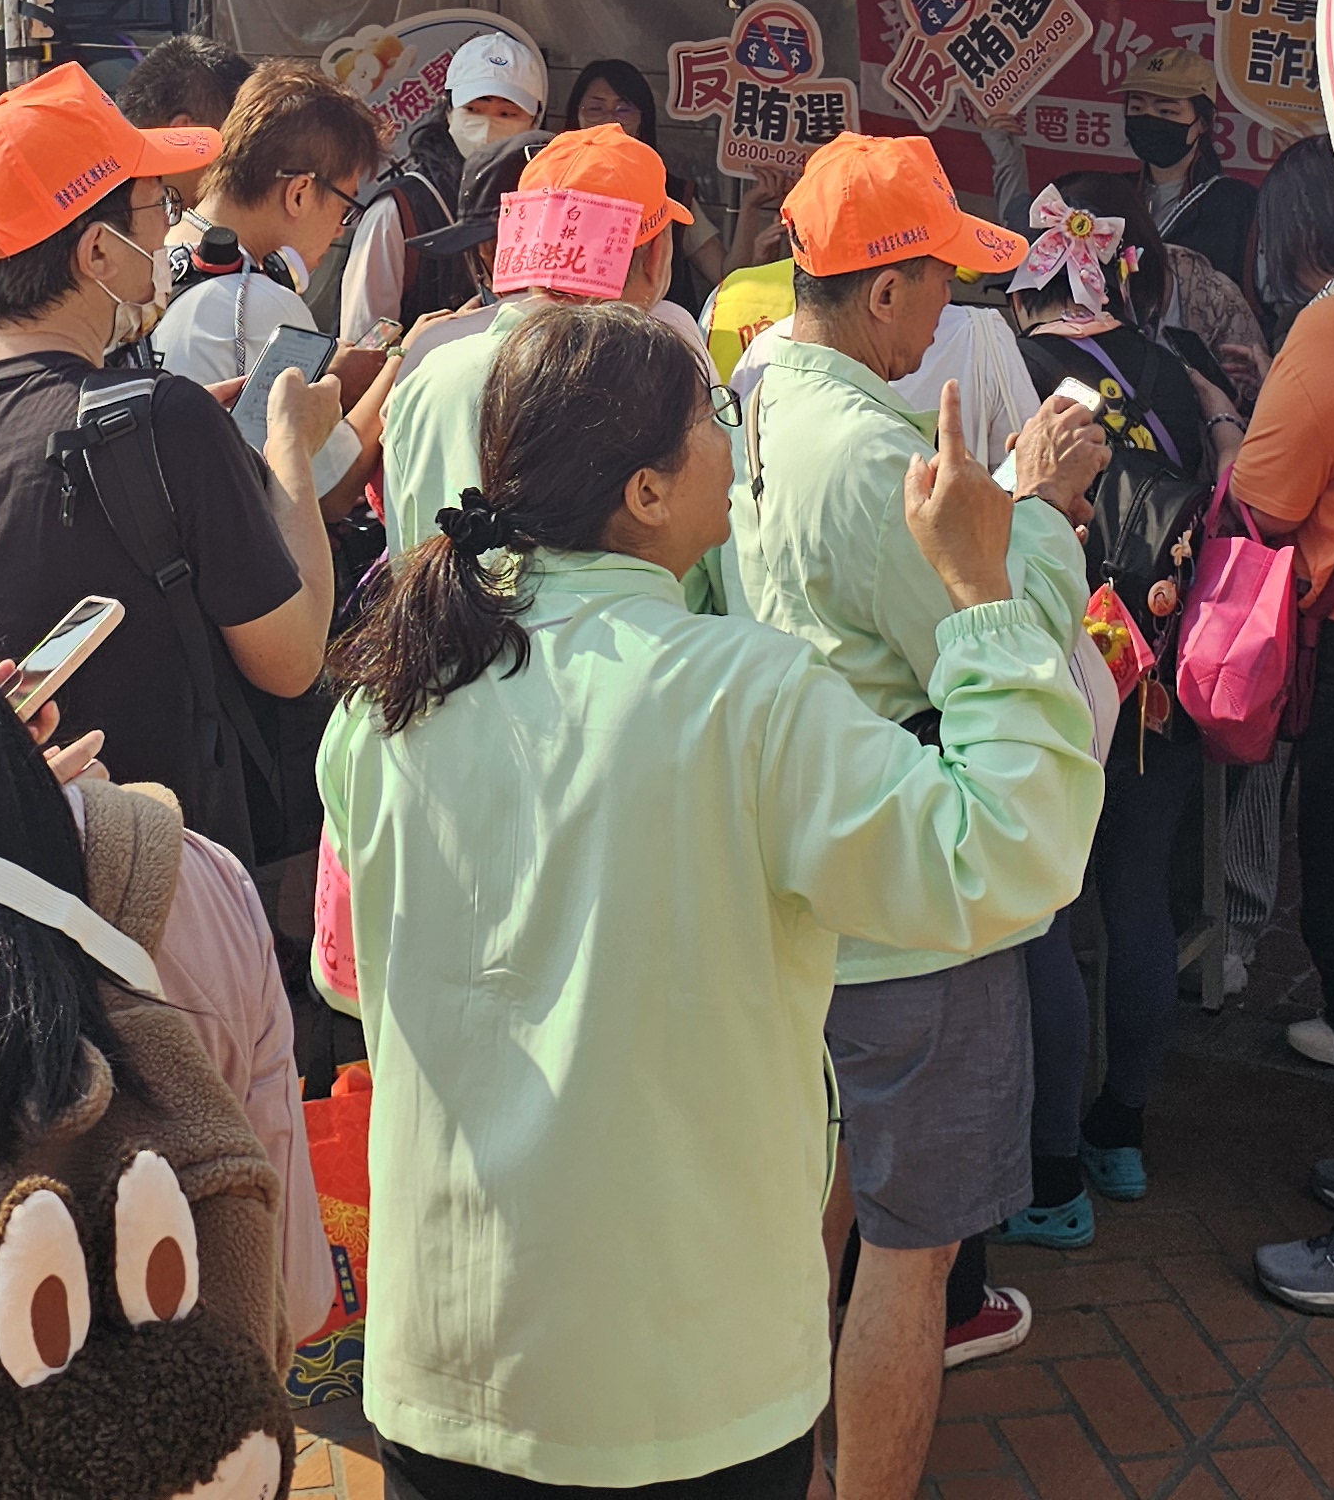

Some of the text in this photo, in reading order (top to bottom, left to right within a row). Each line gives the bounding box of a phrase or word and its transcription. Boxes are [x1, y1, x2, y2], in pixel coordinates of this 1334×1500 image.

[677, 47, 734, 110] 反
[891, 36, 957, 121] 反
[983, 11, 1075, 108] 0800-024-099
[733, 82, 845, 144] 賄選
